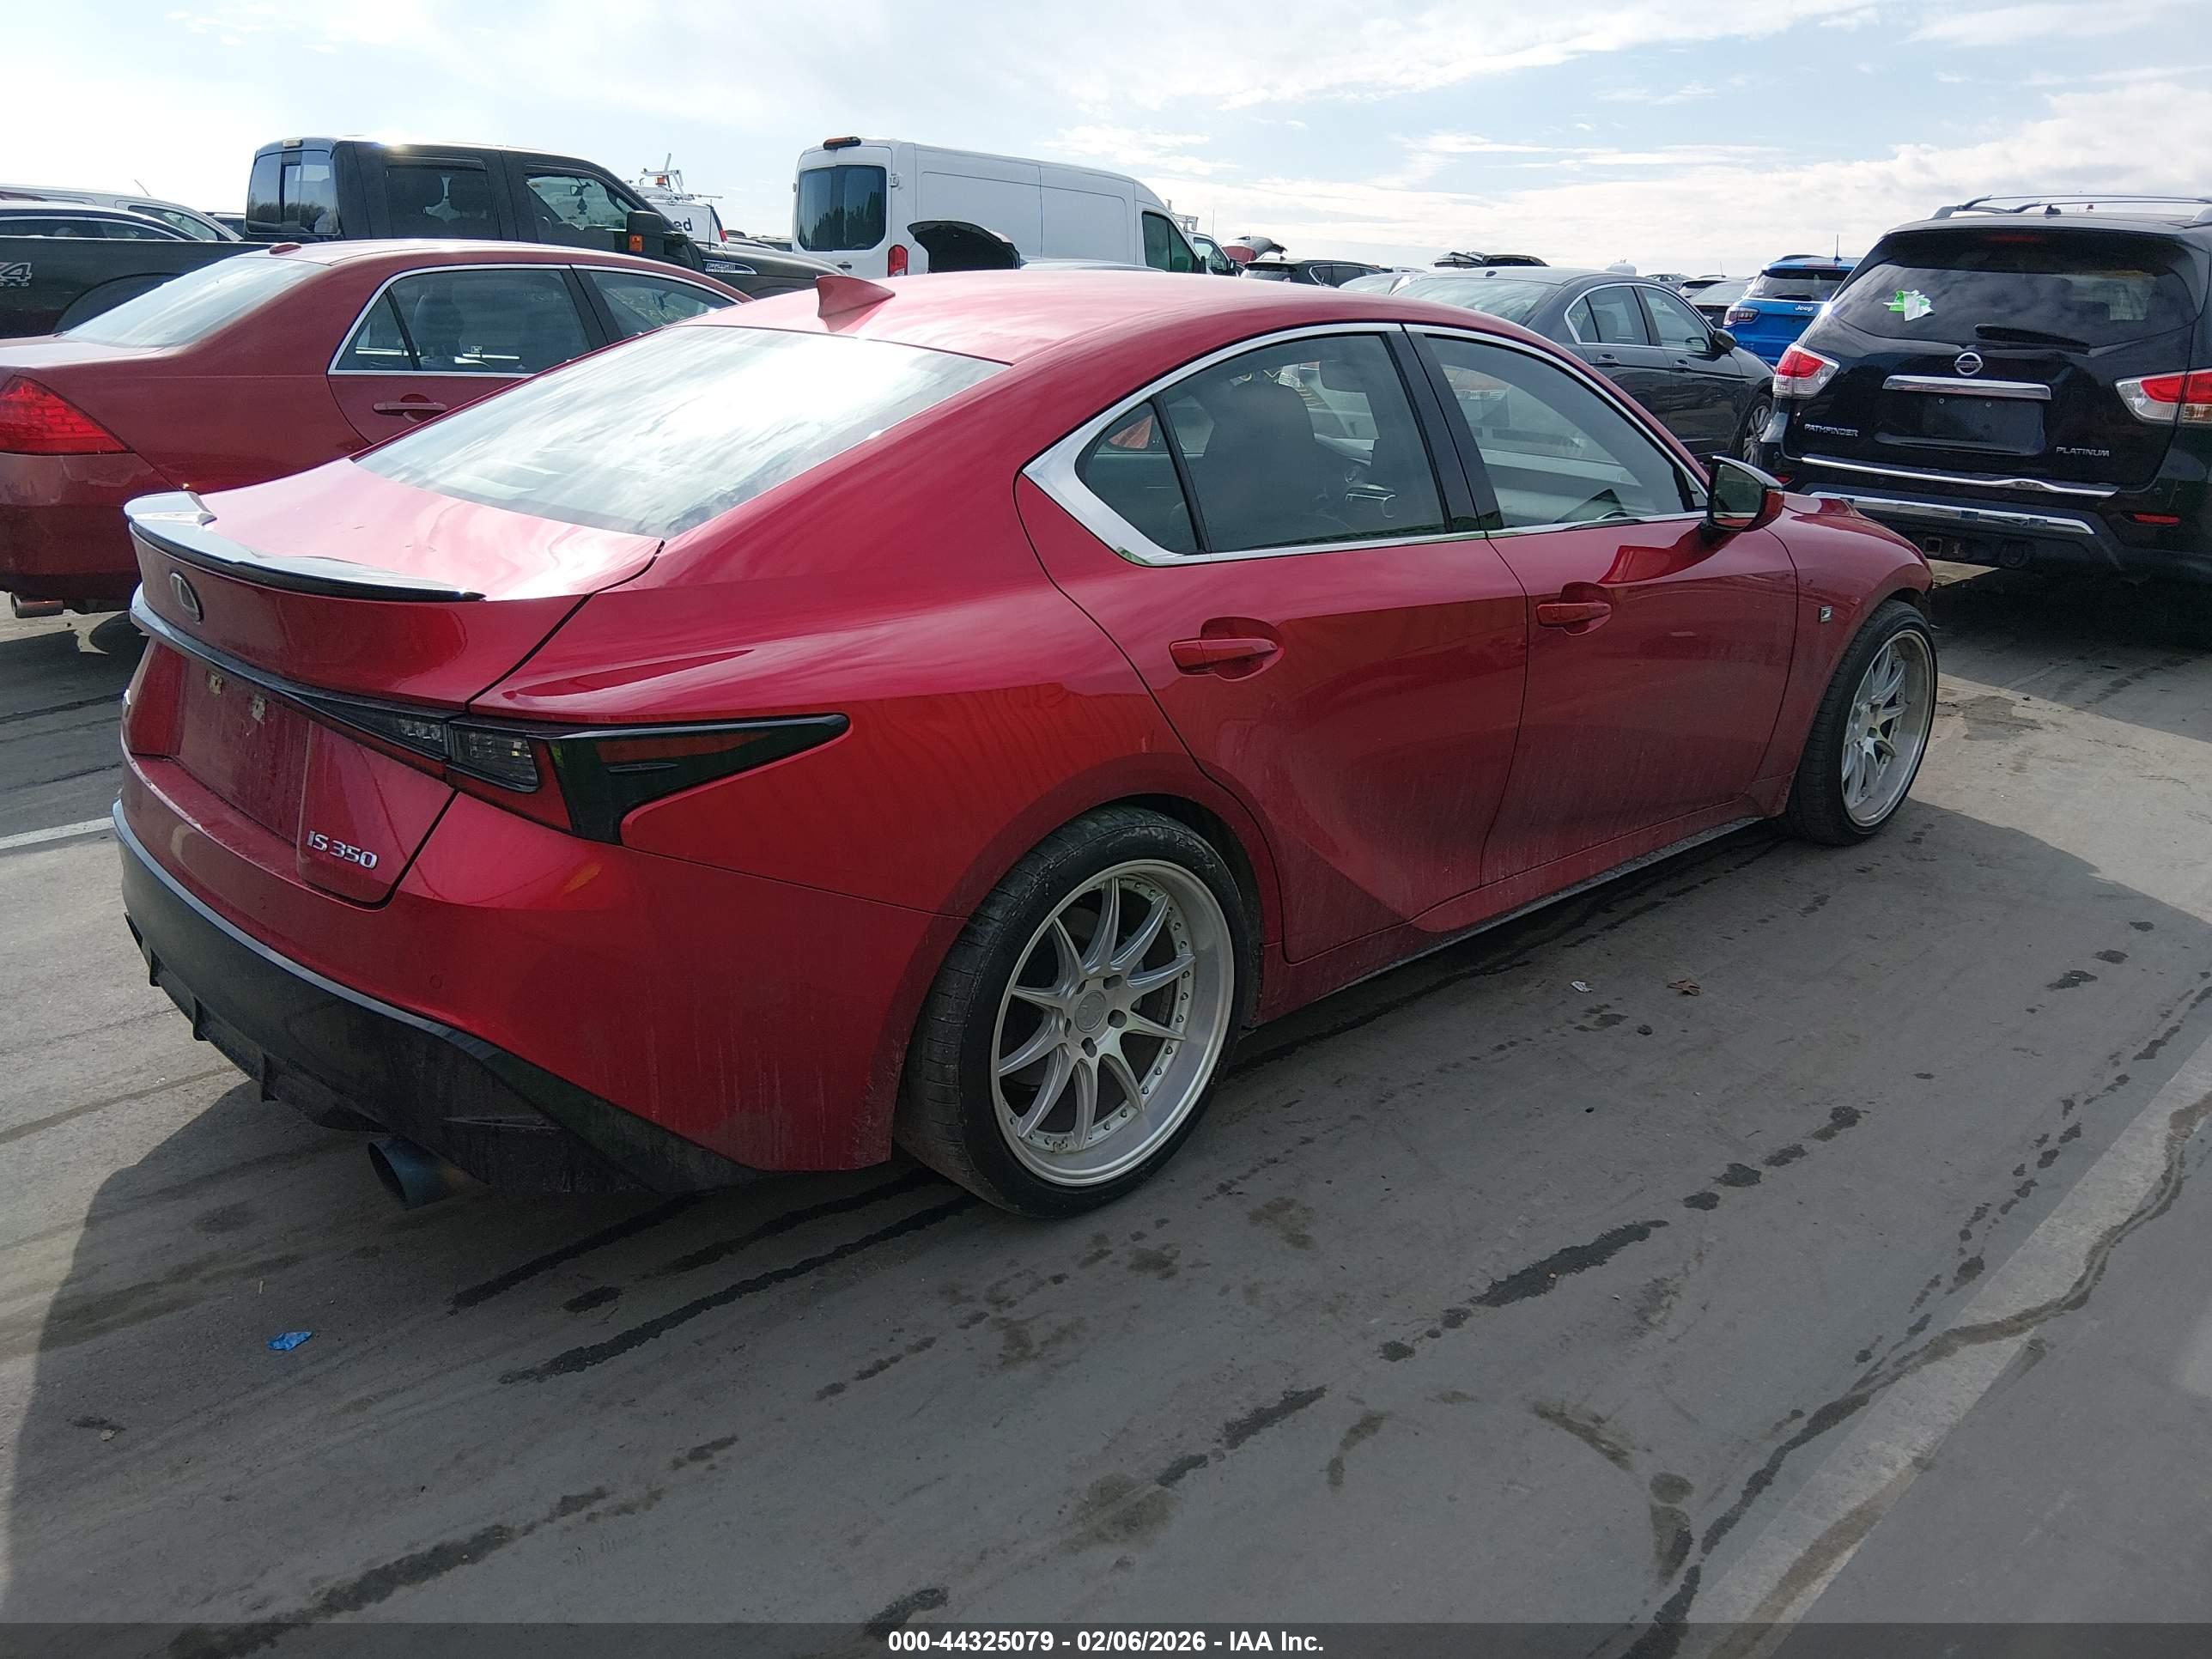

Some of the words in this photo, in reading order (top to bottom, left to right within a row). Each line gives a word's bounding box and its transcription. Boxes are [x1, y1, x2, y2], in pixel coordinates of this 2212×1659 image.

[1804, 423, 1858, 437] PATHFINDER
[2056, 447, 2110, 457] PLATINUM
[307, 830, 329, 851] IS
[329, 840, 378, 869] 350
